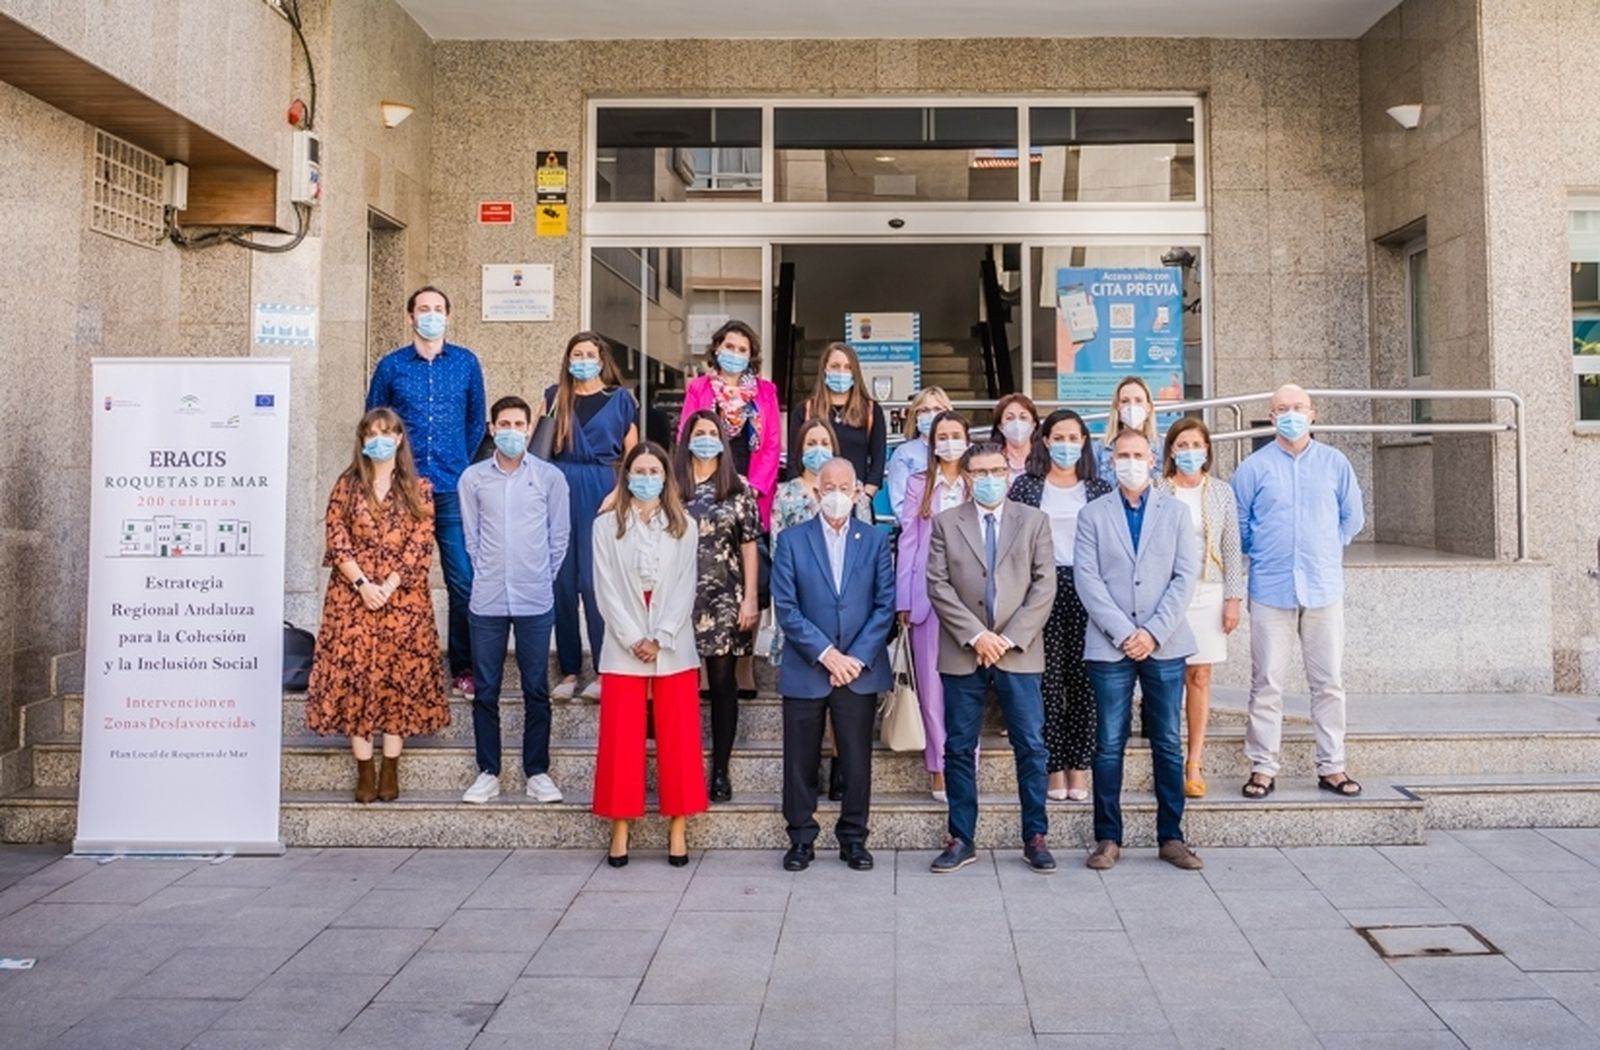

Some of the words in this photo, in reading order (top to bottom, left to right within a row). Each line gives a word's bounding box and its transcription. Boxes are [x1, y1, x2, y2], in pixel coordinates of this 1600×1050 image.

[1102, 272, 1132, 281] Acceso
[1154, 273, 1170, 281] con
[1091, 282, 1123, 297] CITA
[1126, 282, 1179, 297] PREVIA
[149, 450, 227, 468] ERACIS
[104, 475, 199, 490] ROQUETAS
[204, 475, 226, 488] DE
[231, 475, 269, 488] MAR
[137, 495, 165, 507] 200
[170, 495, 237, 507] culturas
[145, 575, 224, 592] Estrategia
[111, 602, 179, 620] Regional
[184, 602, 255, 617] Andaluza
[118, 633, 152, 648] para
[157, 630, 170, 643] la
[175, 629, 247, 643] Cohesión
[103, 660, 113, 675] y
[118, 657, 132, 670] la
[137, 656, 208, 670] Inclusión
[212, 656, 259, 670] Social
[126, 696, 217, 709] Intervención
[218, 699, 236, 709] en
[103, 716, 147, 730] Zonas
[149, 716, 256, 730] Desfavorecidas
[110, 750, 131, 759] Plan
[132, 750, 158, 759] Local
[158, 750, 170, 759] de
[171, 750, 215, 760] Roquetas
[215, 749, 228, 759] de
[229, 750, 248, 759] Mar
